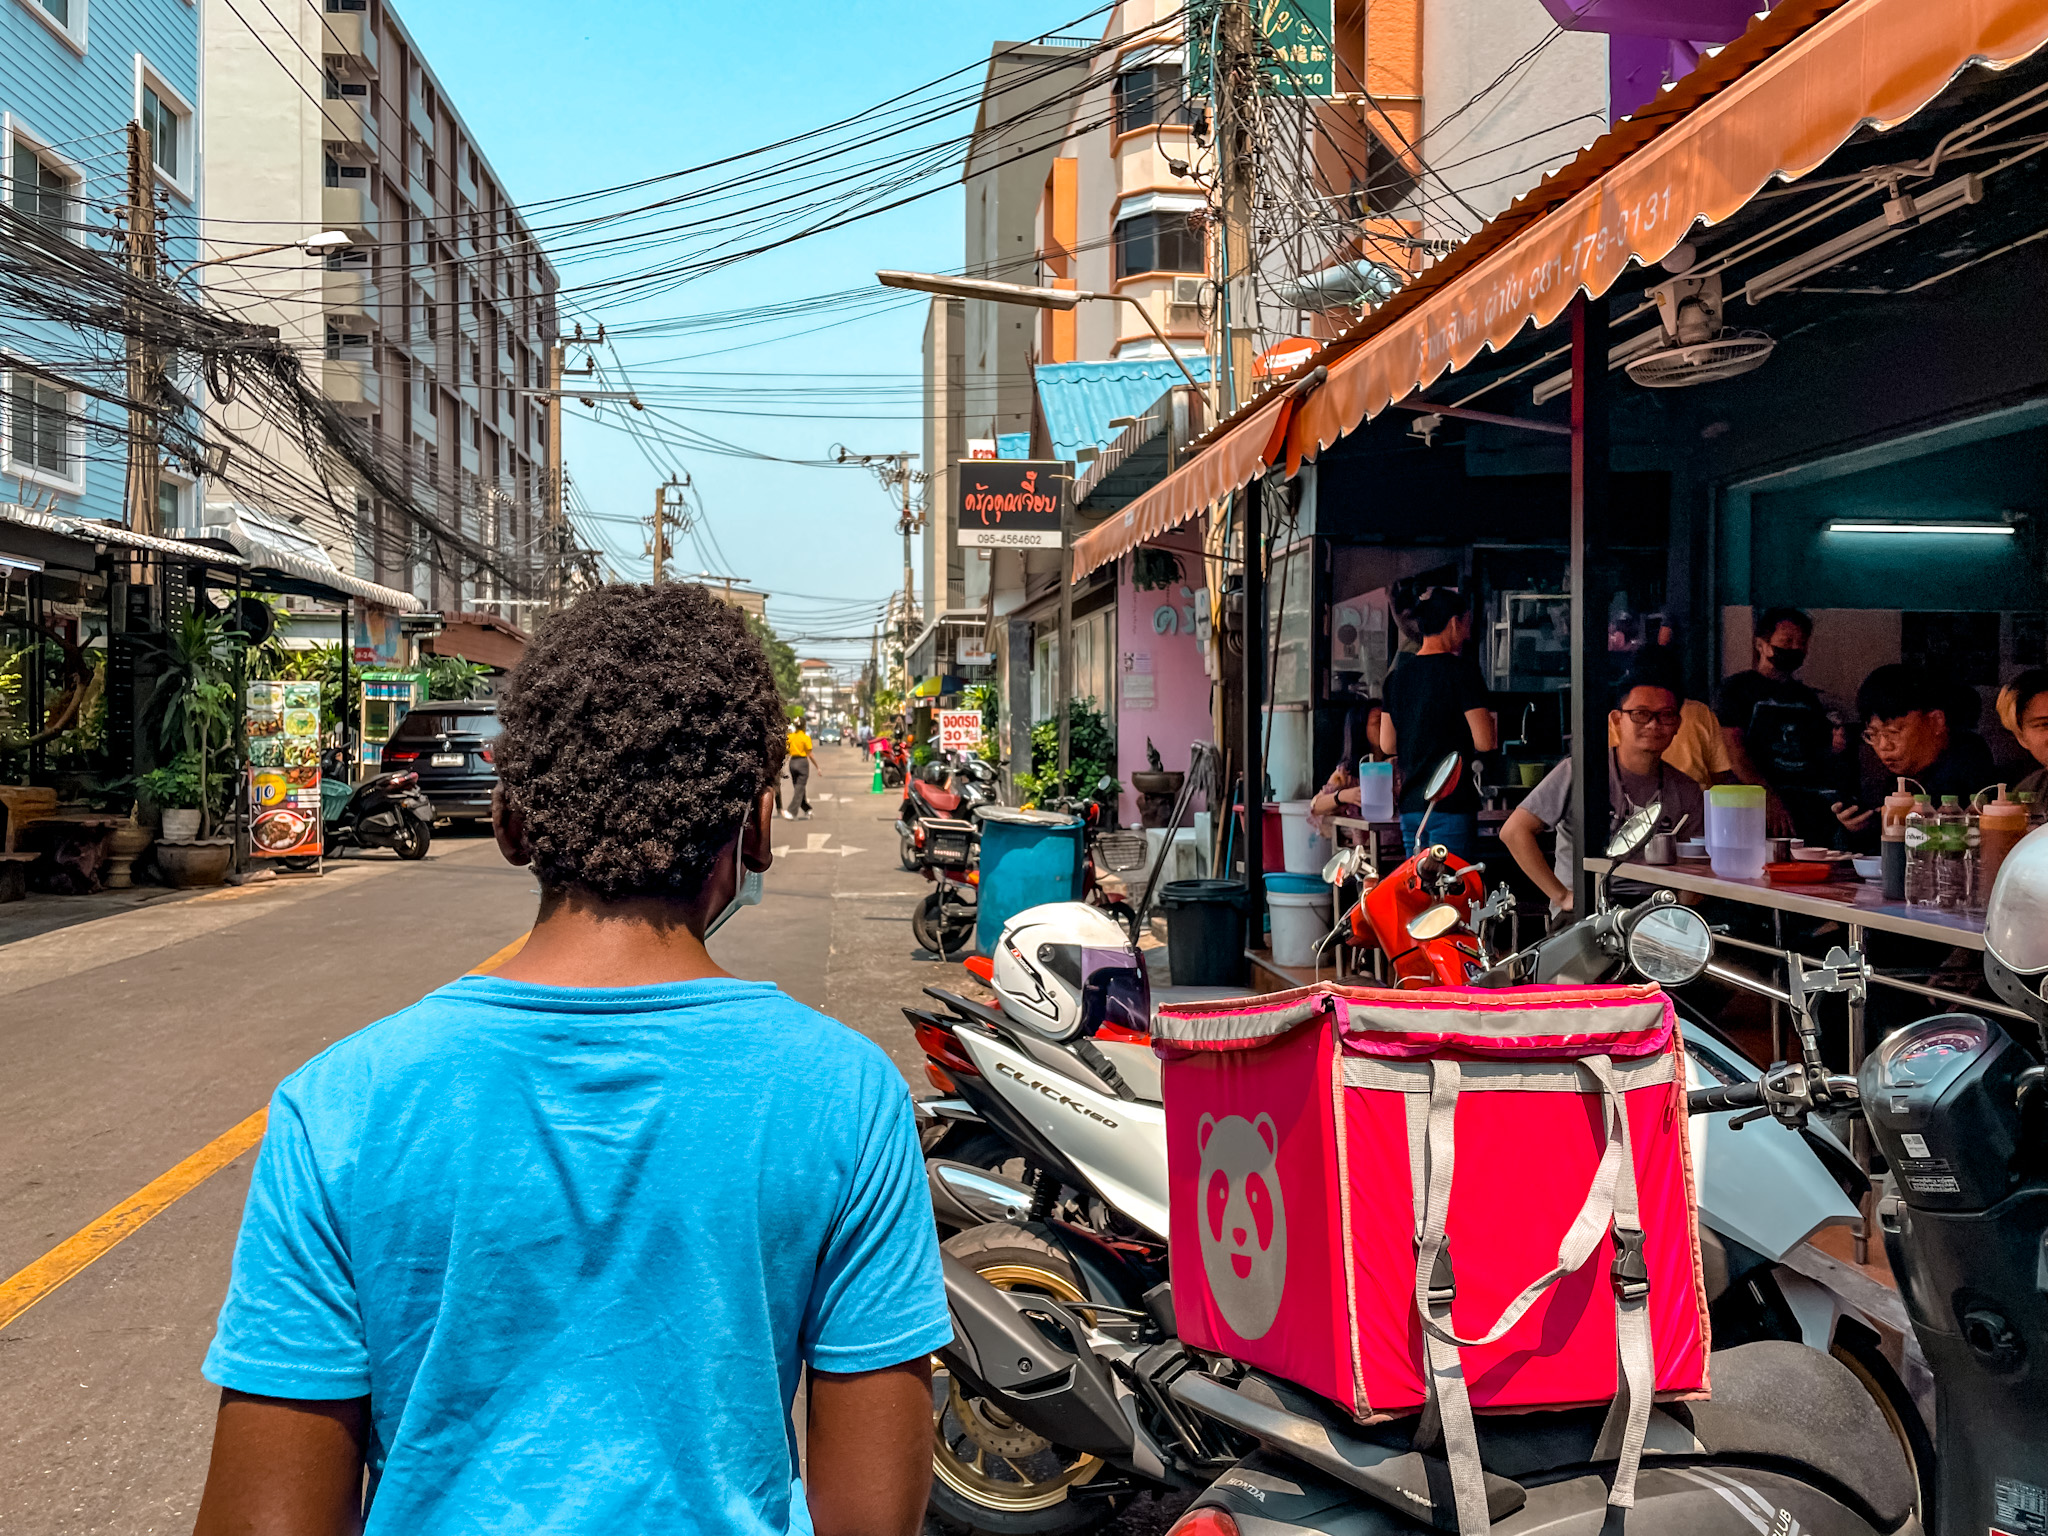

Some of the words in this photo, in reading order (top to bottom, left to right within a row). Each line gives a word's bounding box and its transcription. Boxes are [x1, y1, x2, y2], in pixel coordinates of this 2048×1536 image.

[977, 533, 1042, 546] 095-4564602
[943, 730, 962, 741] 30
[1226, 1477, 1266, 1503] HONDA
[1771, 1508, 1792, 1536] LUB
